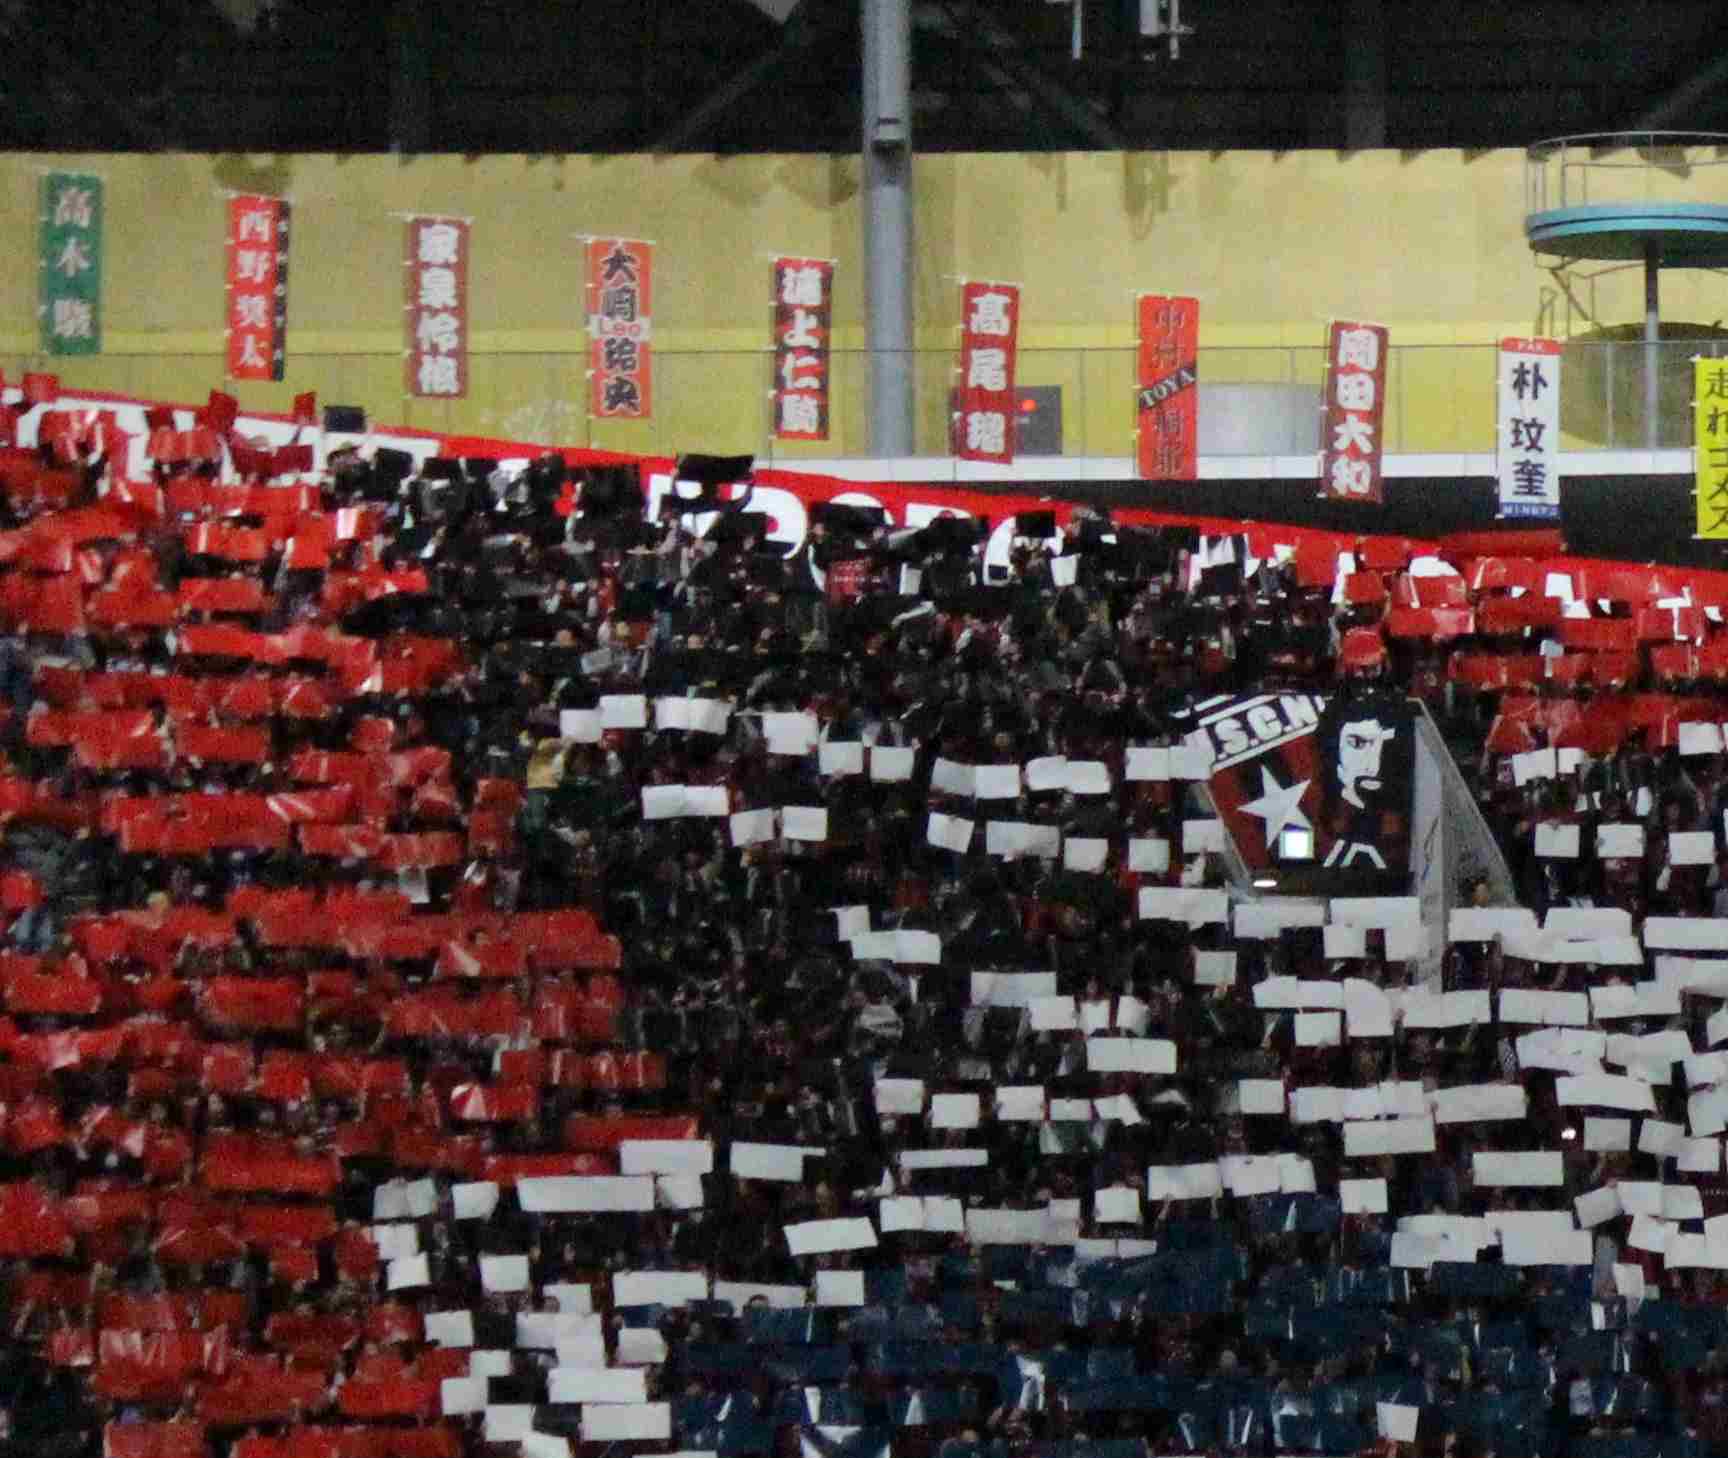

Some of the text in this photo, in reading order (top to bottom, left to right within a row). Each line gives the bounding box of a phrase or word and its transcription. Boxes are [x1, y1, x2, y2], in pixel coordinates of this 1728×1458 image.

[1140, 367, 1197, 408] TOYA
[1331, 328, 1379, 494] 岡田大和
